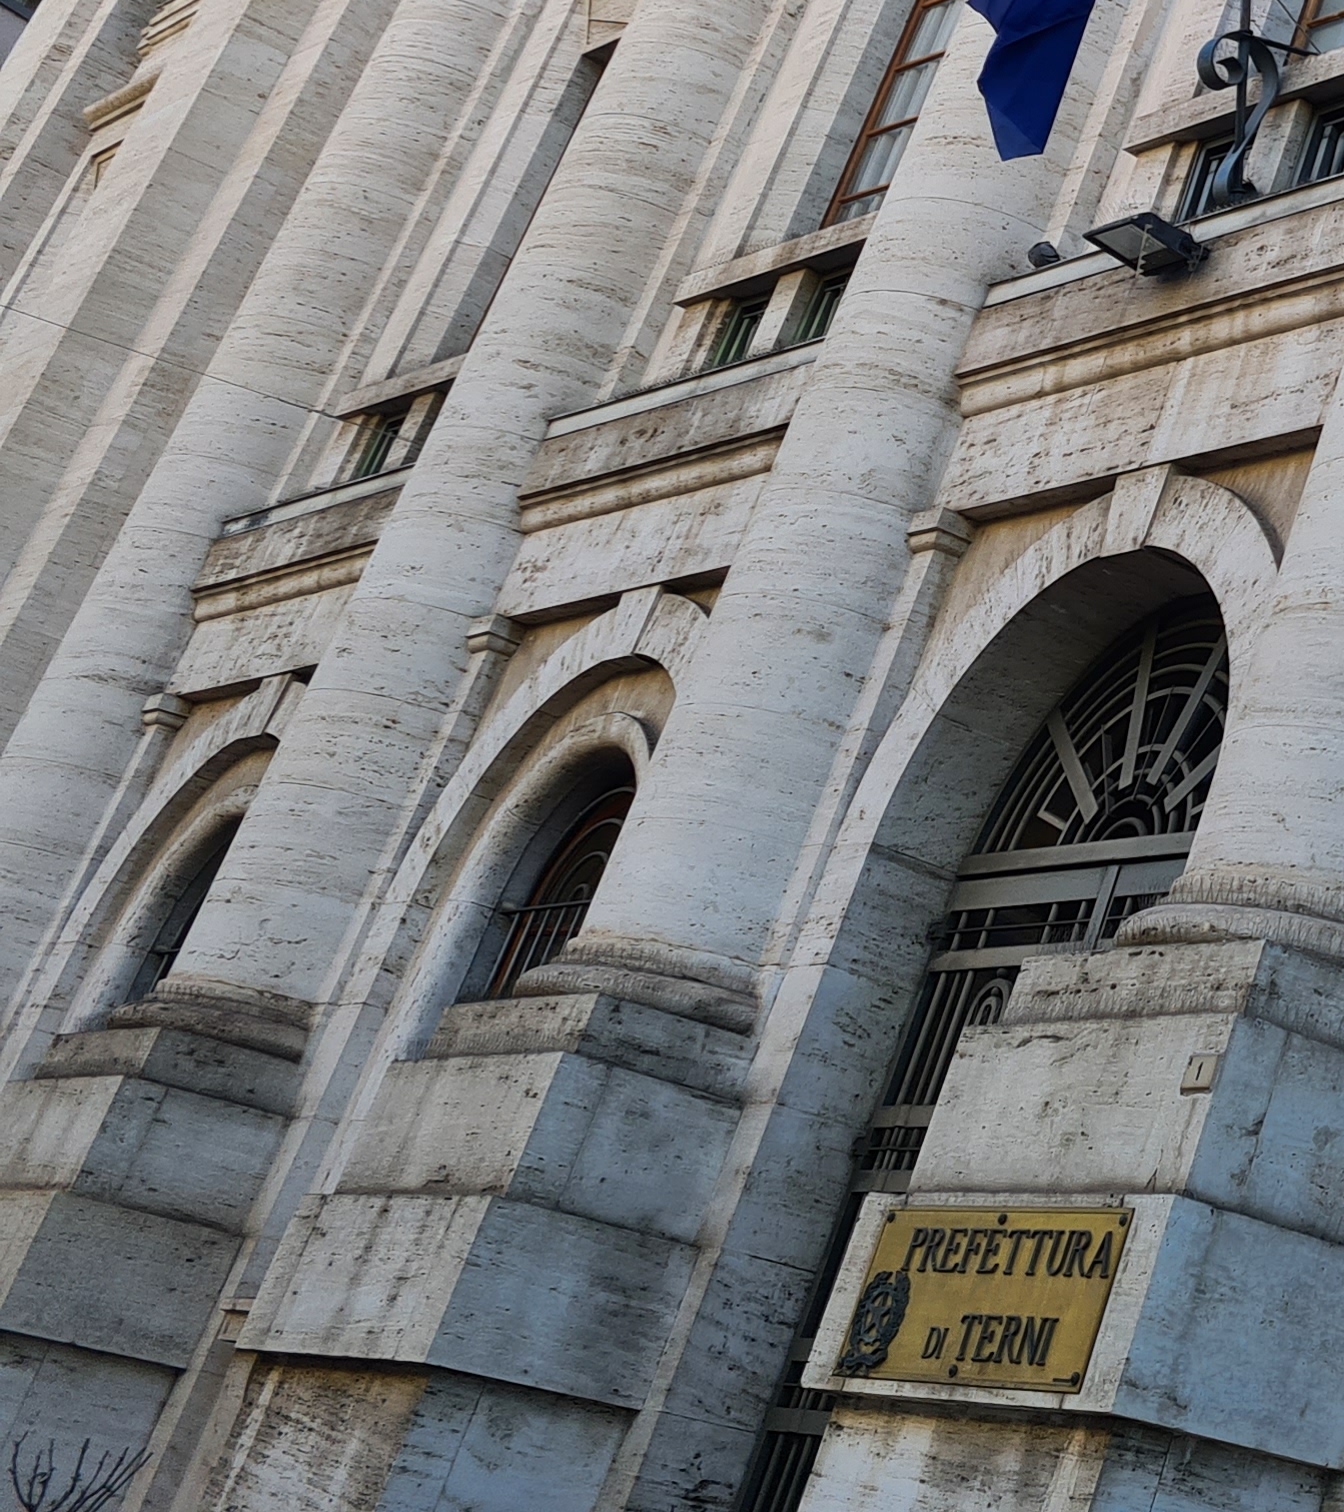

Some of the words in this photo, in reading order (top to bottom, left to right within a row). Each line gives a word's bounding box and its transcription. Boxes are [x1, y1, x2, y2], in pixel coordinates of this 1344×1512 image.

[902, 1227, 1114, 1279] PREFETTURA
[921, 1326, 950, 1359] DI
[956, 1314, 1060, 1366] TERNI
